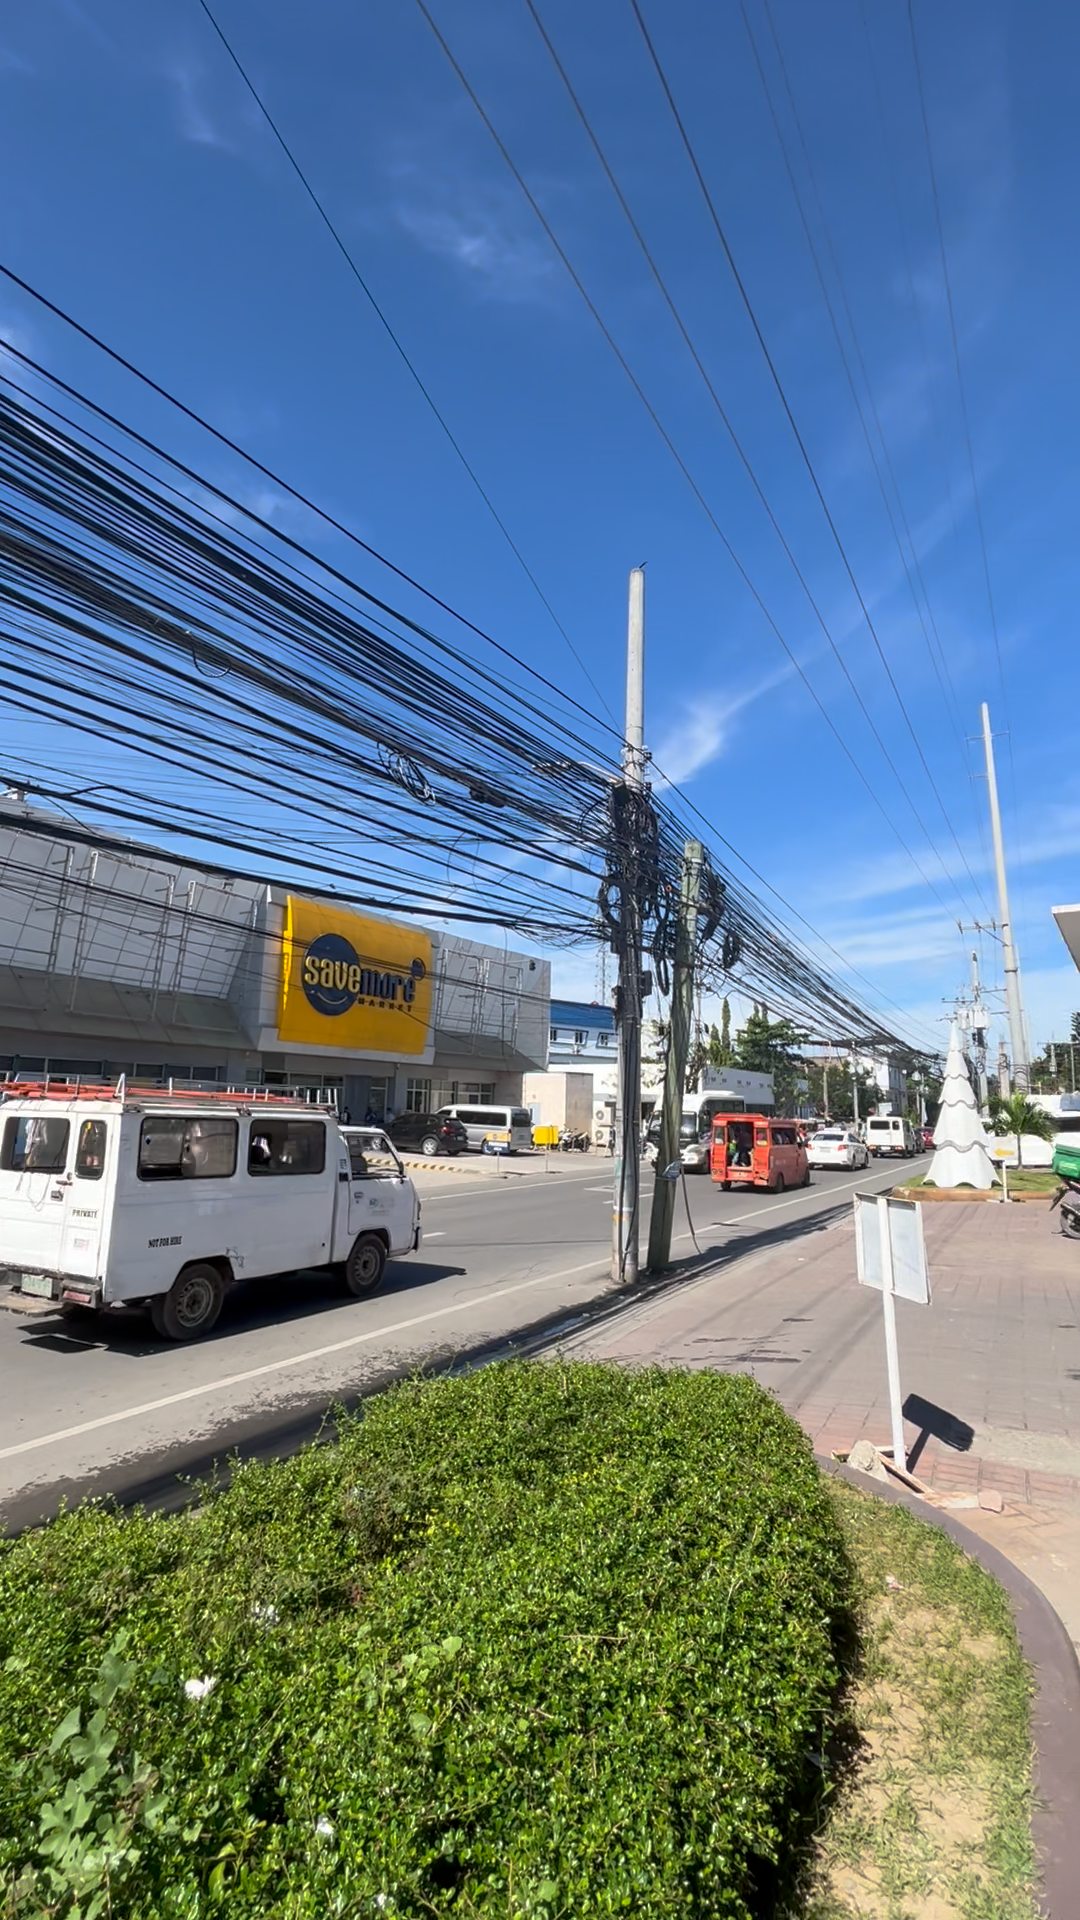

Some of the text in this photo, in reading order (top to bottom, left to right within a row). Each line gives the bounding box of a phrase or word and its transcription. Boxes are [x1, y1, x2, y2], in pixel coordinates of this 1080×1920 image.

[358, 997, 412, 1012] MARKET
[72, 1209, 98, 1218] PRIVATE
[148, 1236, 182, 1248] NOT FOR HIRE
